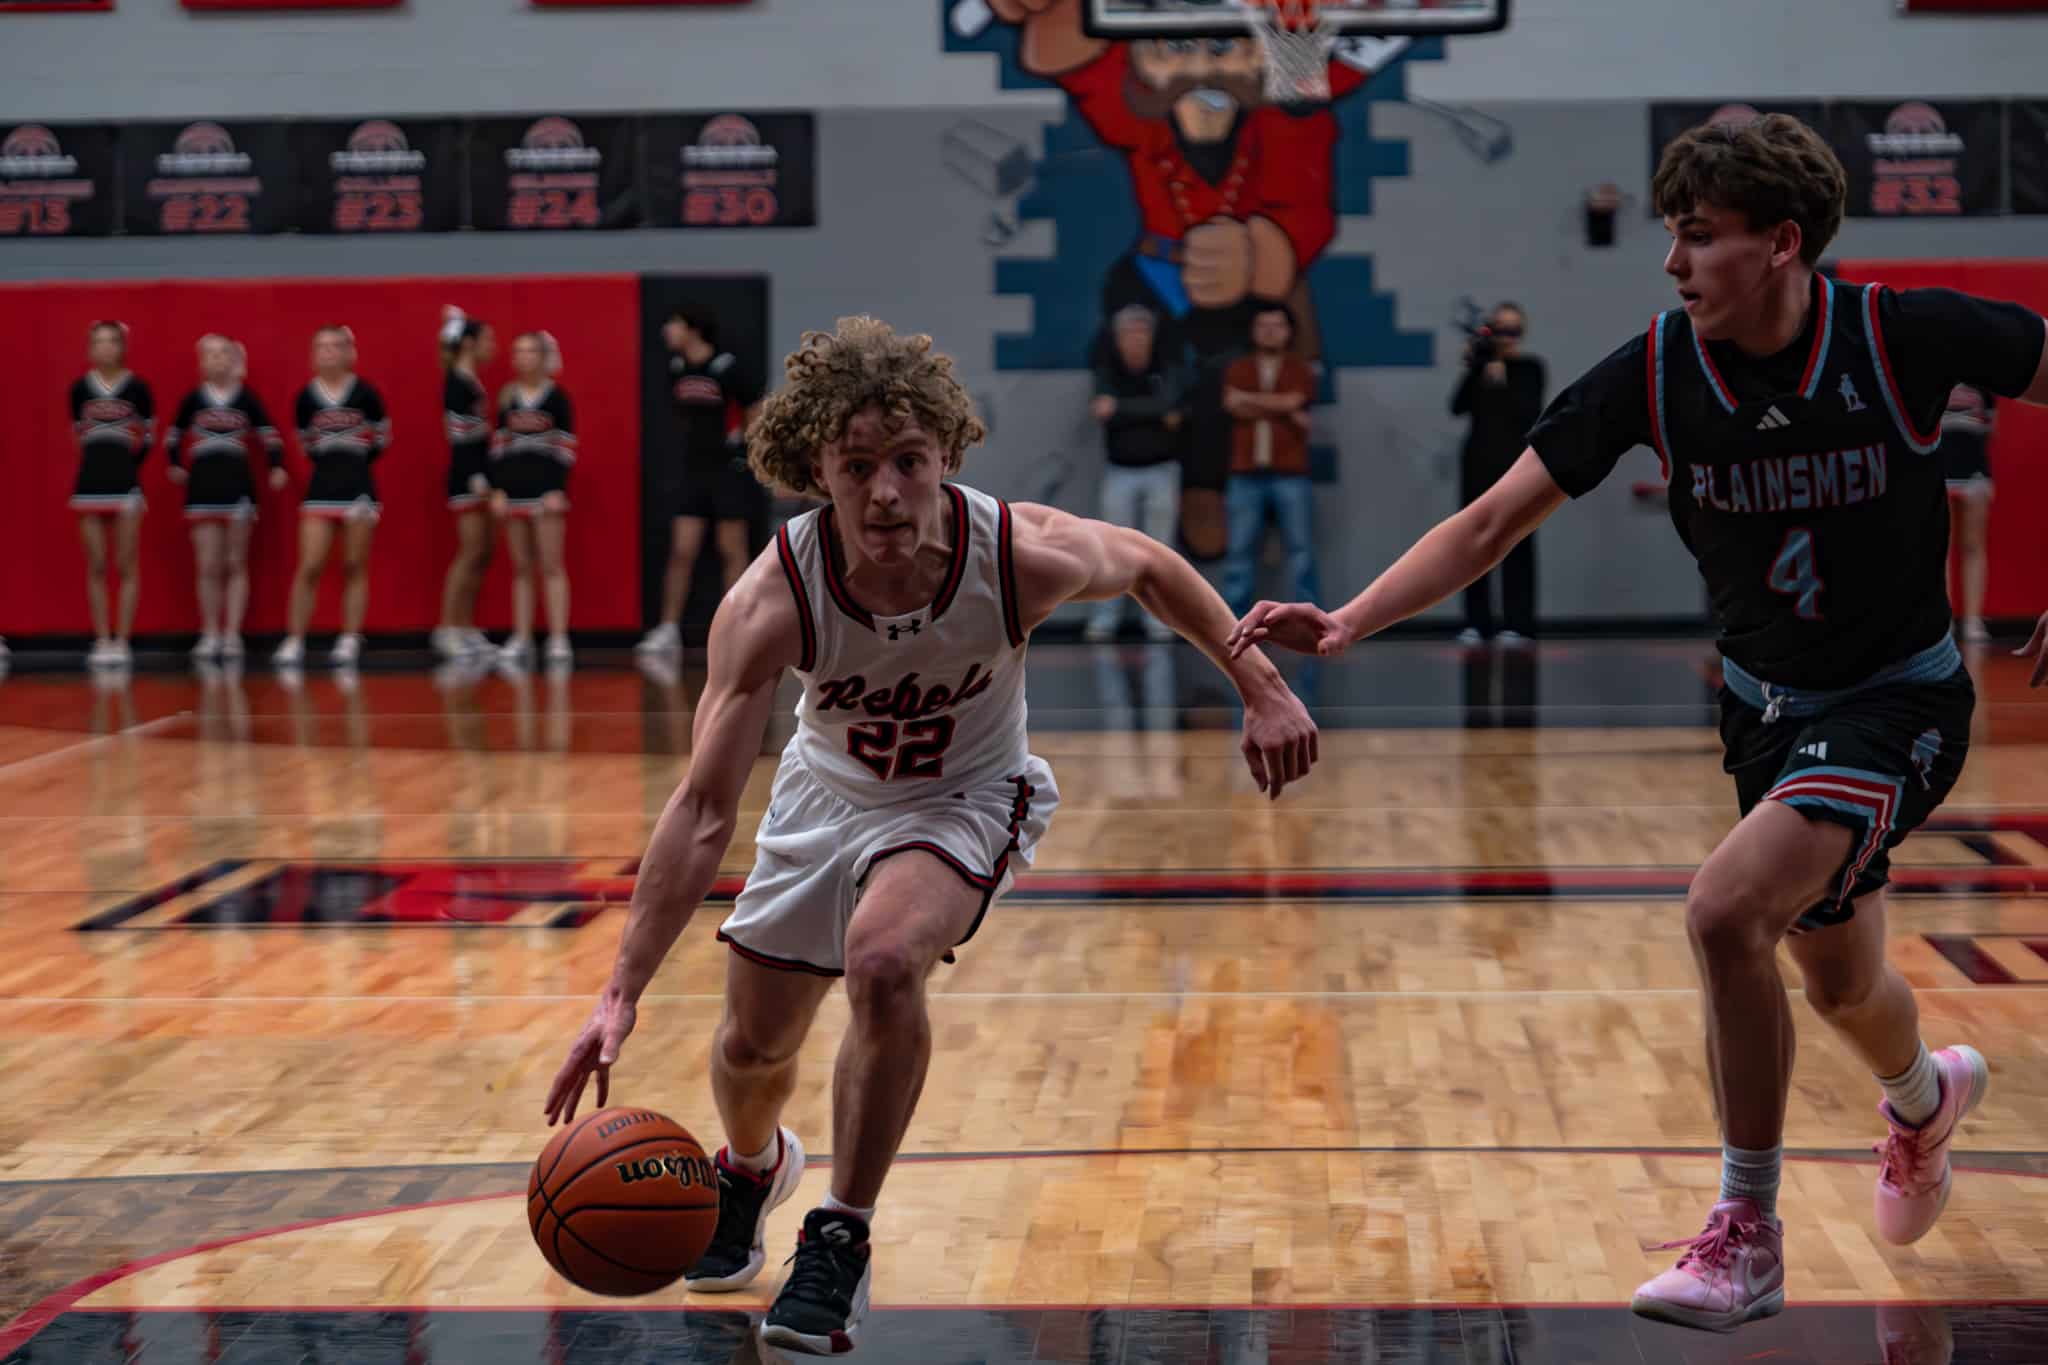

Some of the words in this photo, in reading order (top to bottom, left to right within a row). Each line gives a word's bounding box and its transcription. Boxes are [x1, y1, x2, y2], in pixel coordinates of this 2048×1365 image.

[1690, 443, 1887, 513] PLAINSMEN
[1767, 527, 1824, 620] 4
[847, 714, 956, 781] 22
